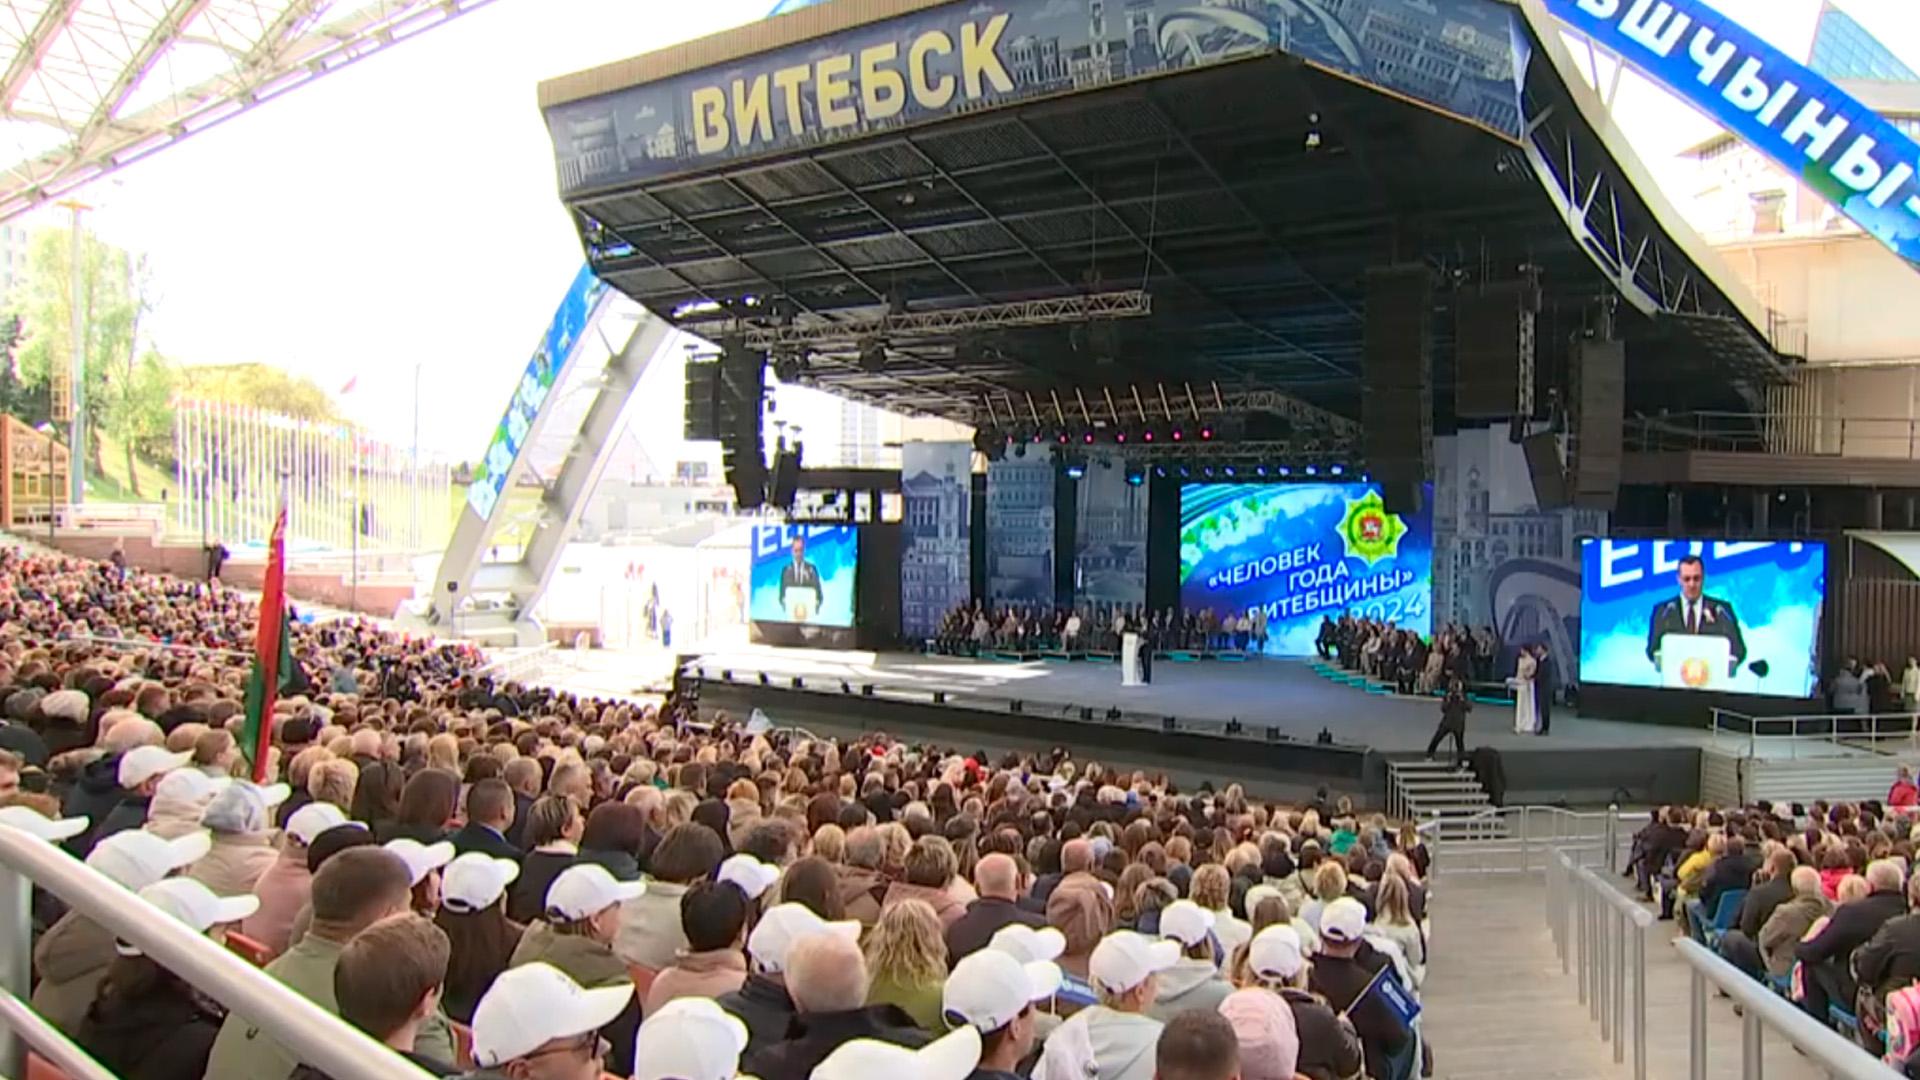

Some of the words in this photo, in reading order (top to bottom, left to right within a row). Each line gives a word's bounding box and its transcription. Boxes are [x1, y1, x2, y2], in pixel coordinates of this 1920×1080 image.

[692, 14, 1014, 153] ВИТЕБСК
[1209, 543, 1321, 588] «ЧЕЛОВЕК
[1289, 561, 1348, 591] ГОДА
